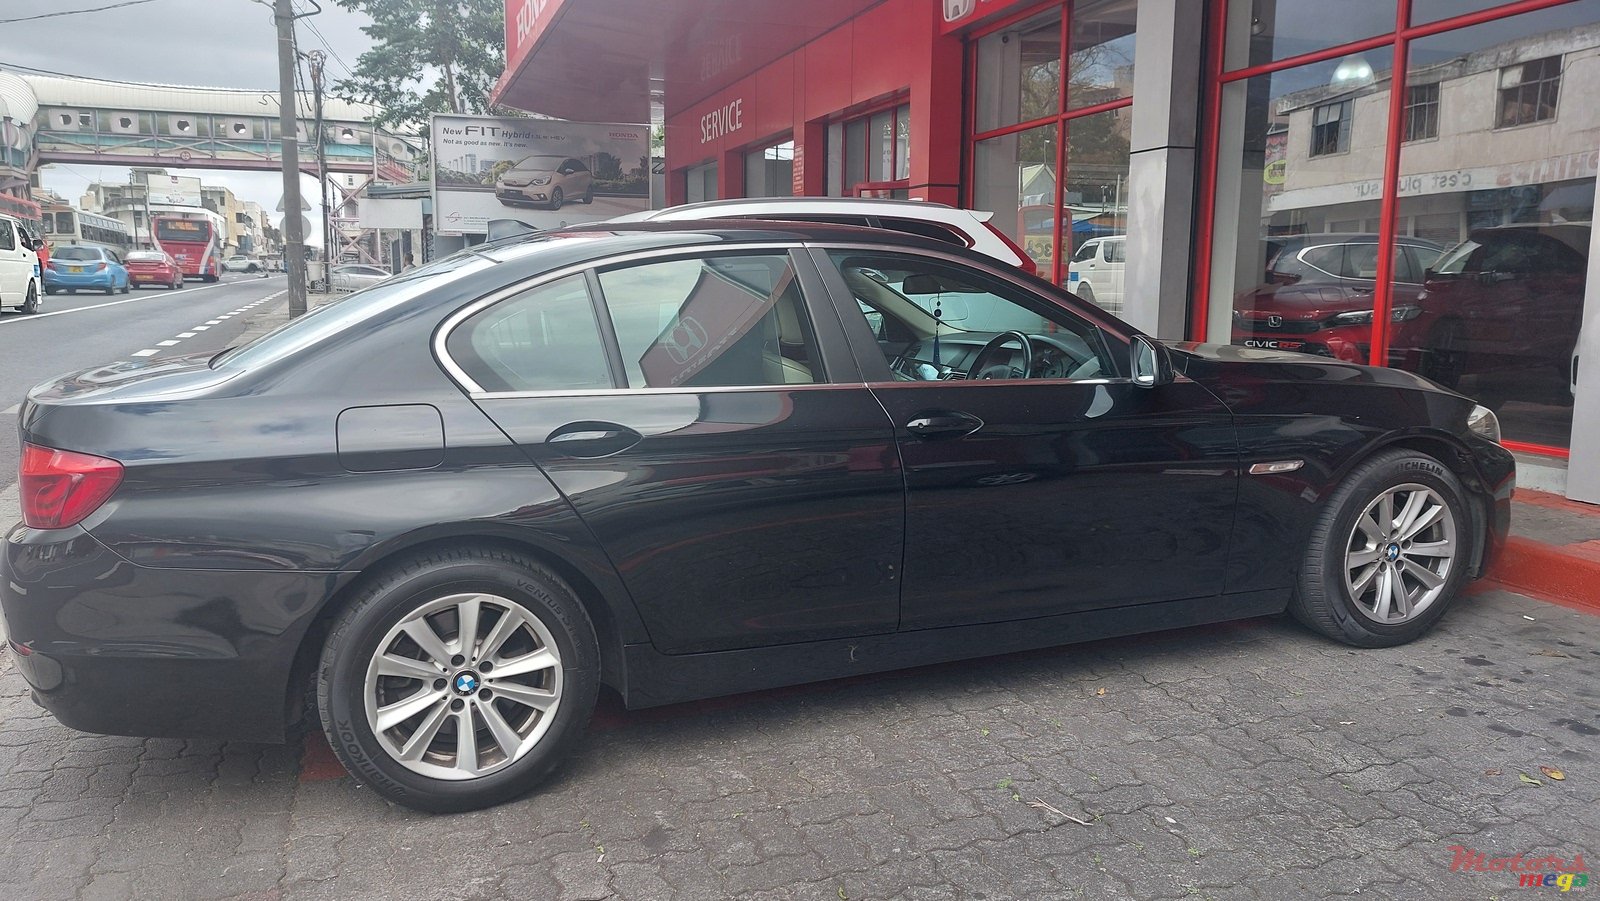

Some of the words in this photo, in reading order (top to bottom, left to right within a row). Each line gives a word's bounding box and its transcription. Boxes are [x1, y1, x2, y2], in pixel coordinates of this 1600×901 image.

[700, 99, 742, 143] SERVICE
[442, 127, 462, 135] New
[465, 125, 501, 136] FIT
[502, 130, 530, 140] Hybrid
[1244, 340, 1278, 348] CIVIC
